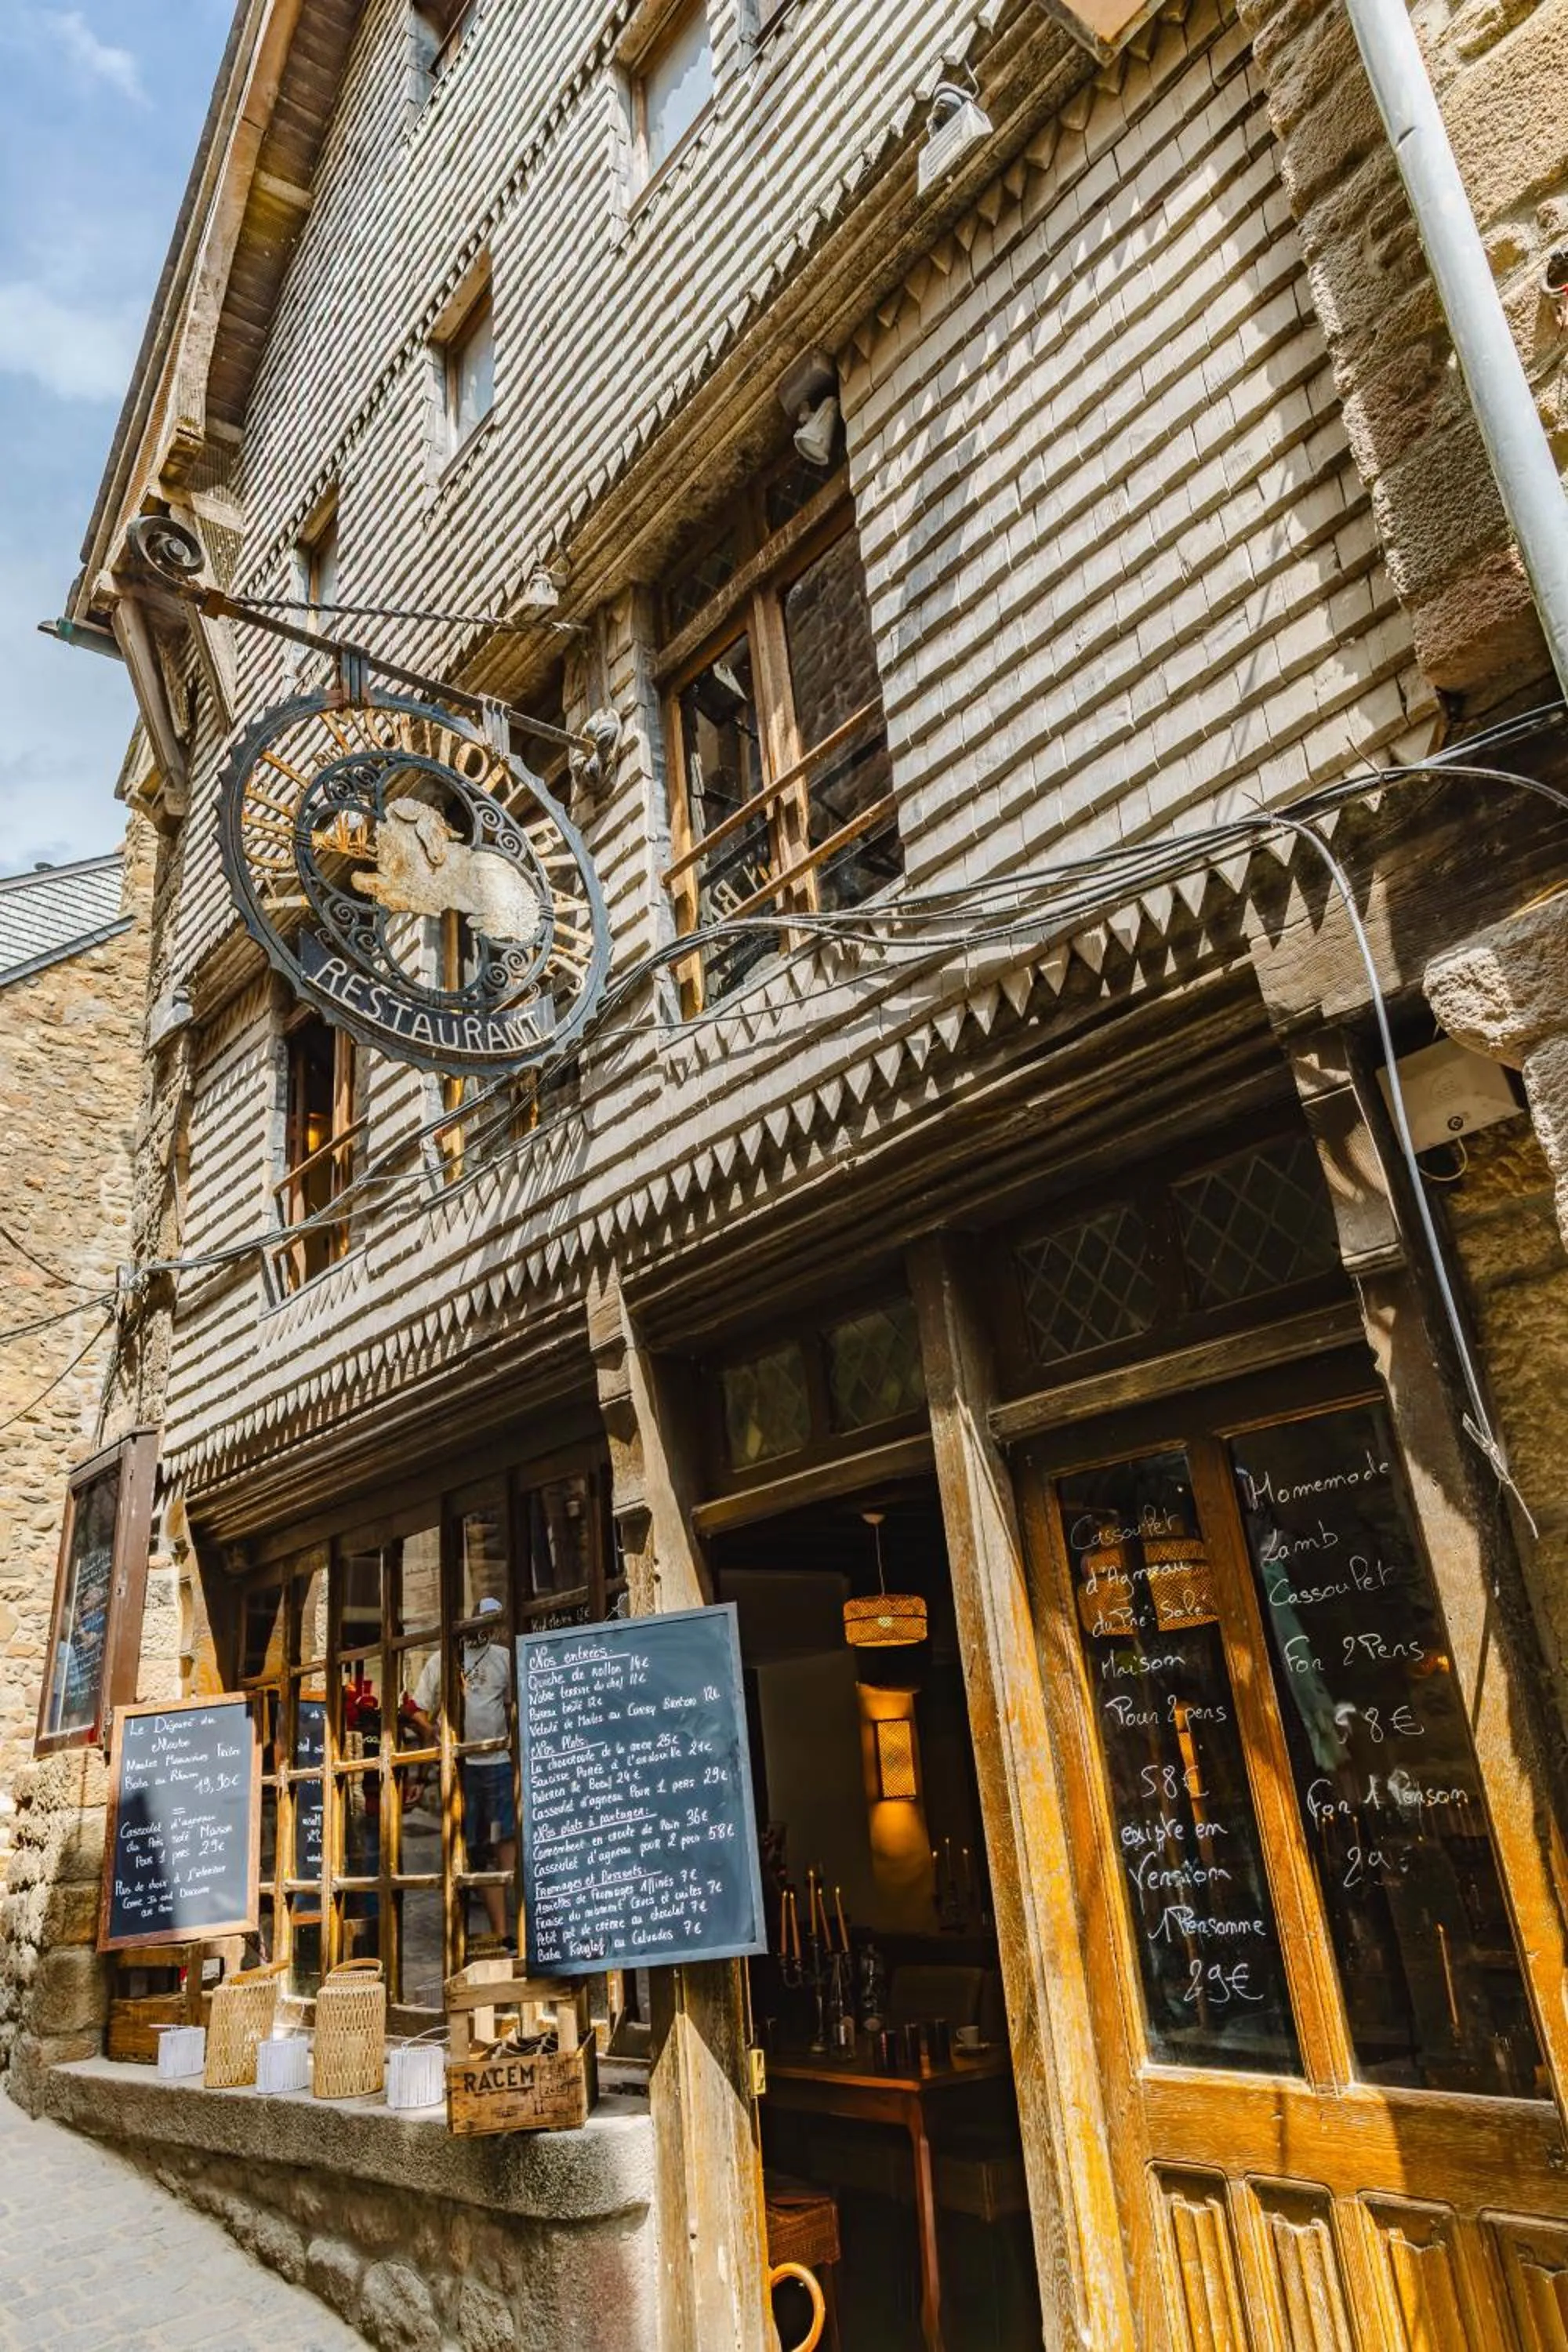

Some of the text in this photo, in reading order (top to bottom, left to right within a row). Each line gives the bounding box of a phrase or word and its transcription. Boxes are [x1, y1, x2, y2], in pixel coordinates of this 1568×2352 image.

[306, 957, 542, 1052] RESTAURANT
[1261, 1519, 1339, 1561] Lamb
[1269, 1555, 1396, 1606] Cassoulet
[1283, 1635, 1325, 1673] For
[1342, 1635, 1356, 1666] 2
[1167, 1694, 1178, 1723] 2
[130, 1719, 144, 1737] Le
[656, 1777, 667, 1794] 1
[1141, 1765, 1210, 1799] 58€
[1307, 1778, 1352, 1831] For
[667, 1831, 677, 1848] 2
[1183, 1959, 1265, 2002] 29€
[463, 2063, 535, 2093] RACEM
